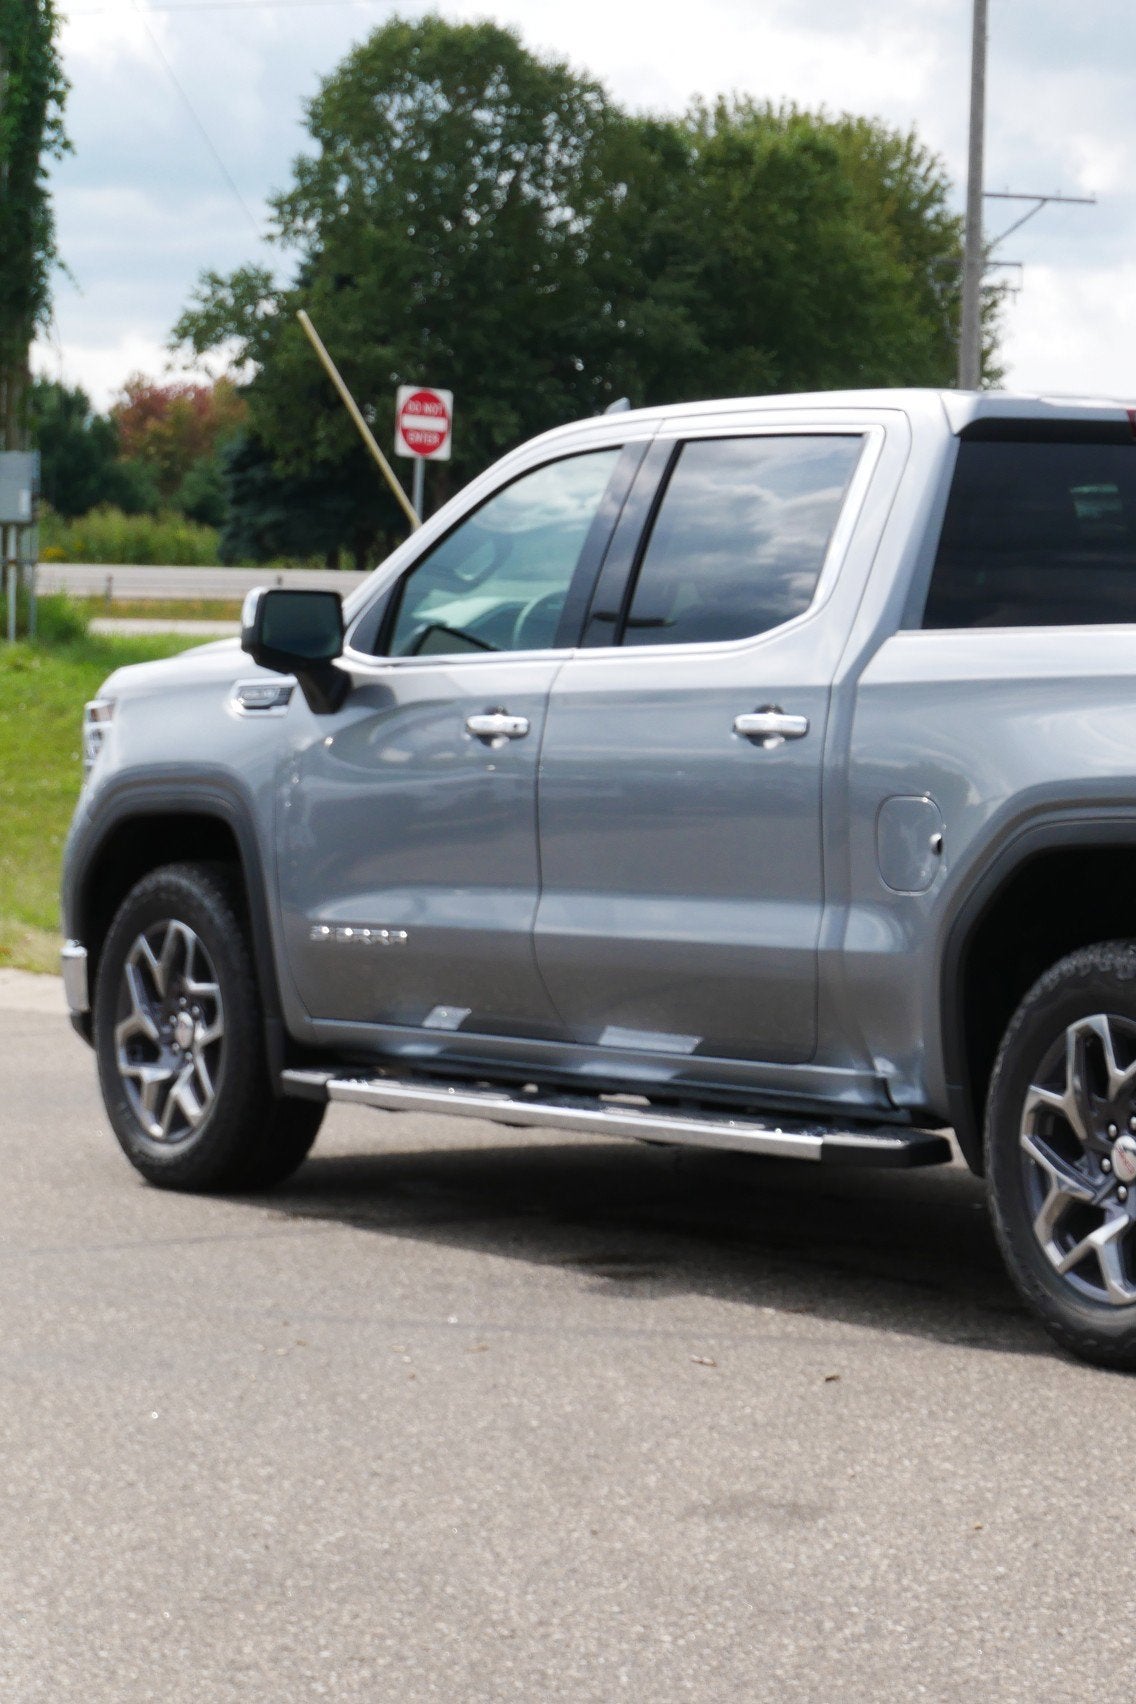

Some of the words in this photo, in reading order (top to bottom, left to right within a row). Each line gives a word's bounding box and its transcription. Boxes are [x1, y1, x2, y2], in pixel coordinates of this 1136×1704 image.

[407, 400, 421, 412] DO
[423, 402, 443, 415] NOT
[407, 431, 440, 445] ENTER
